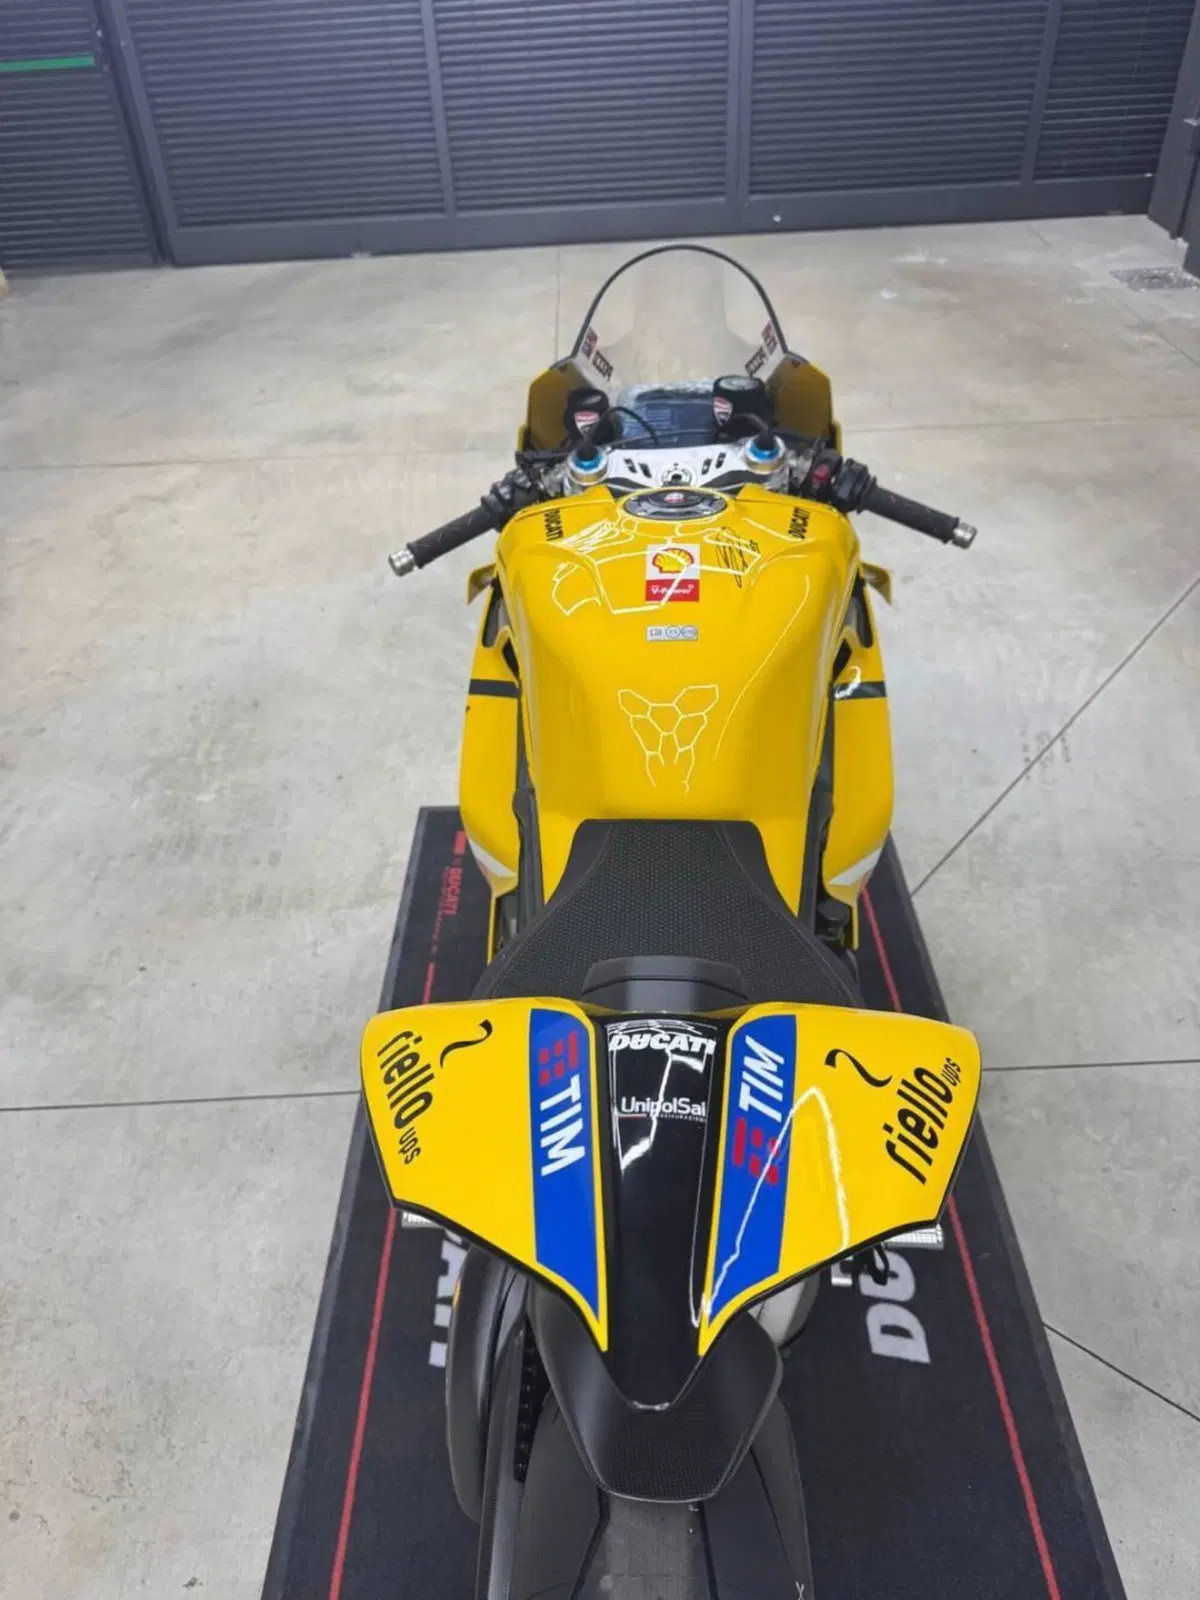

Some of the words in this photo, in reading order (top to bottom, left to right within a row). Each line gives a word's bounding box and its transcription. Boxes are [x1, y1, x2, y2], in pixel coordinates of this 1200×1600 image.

[788, 506, 813, 540] DUCATI
[377, 1030, 435, 1130] riello
[608, 1033, 717, 1055] DUCATI
[738, 1034, 785, 1124] TIM
[398, 1126, 421, 1165] ups
[540, 1073, 586, 1177] TIM
[882, 1066, 953, 1185] riello
[941, 1057, 962, 1088] ups
